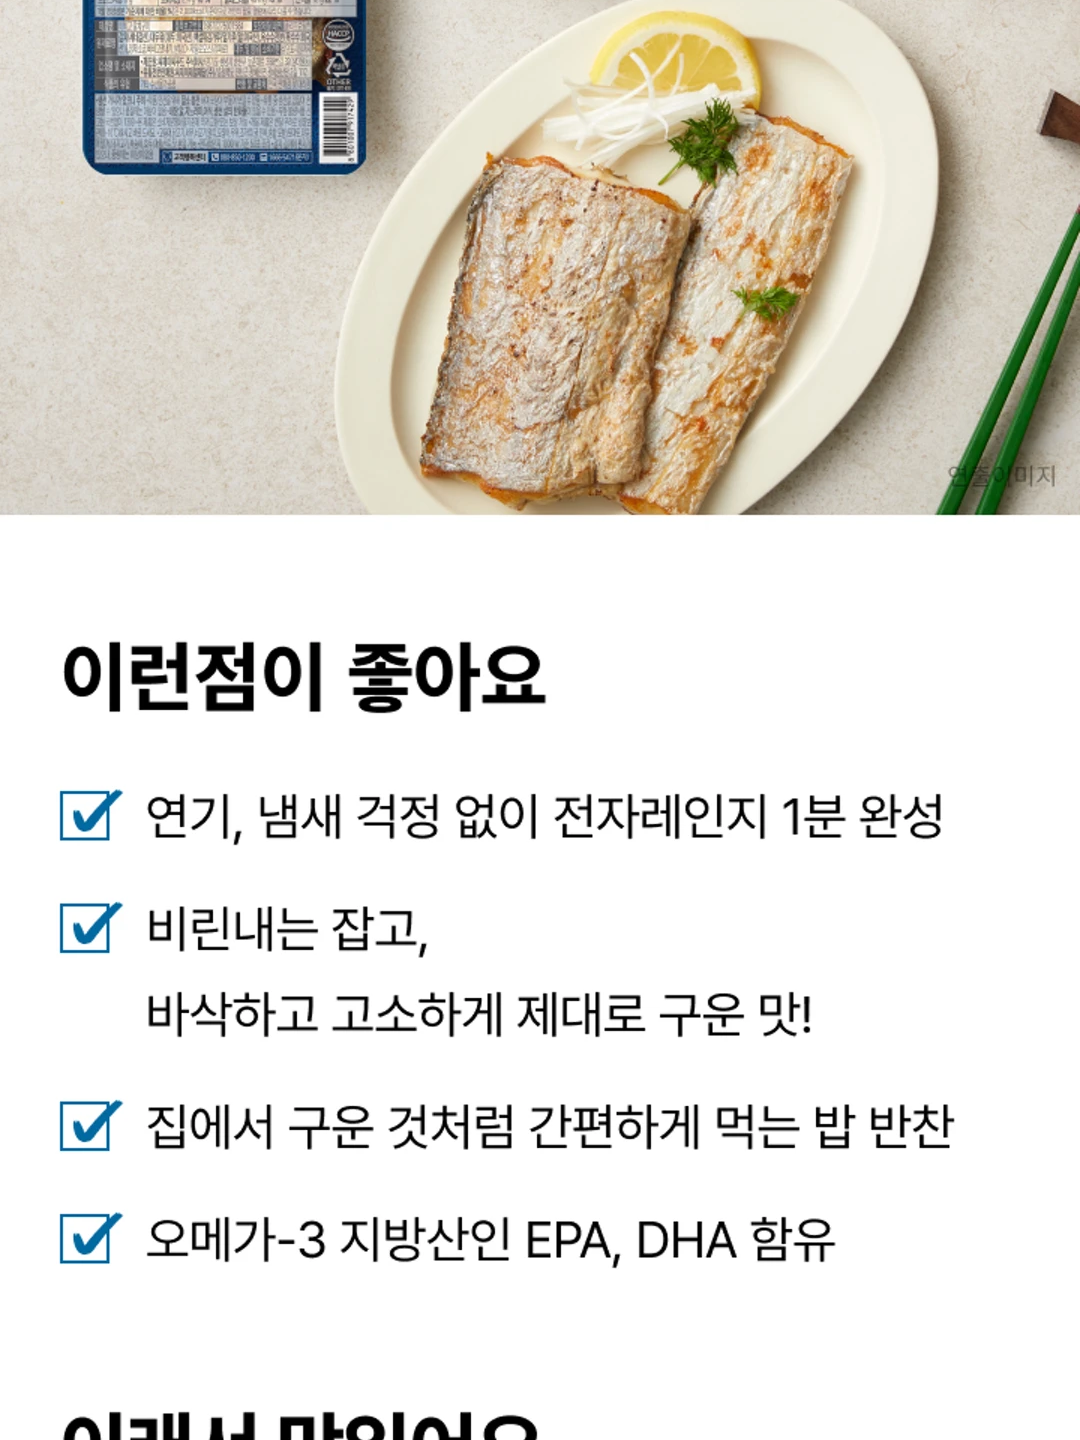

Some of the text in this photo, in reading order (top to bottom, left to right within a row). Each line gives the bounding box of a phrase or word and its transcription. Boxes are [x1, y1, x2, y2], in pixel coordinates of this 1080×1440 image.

[63, 641, 546, 714] 이런점이 좋아요
[147, 793, 941, 846] 연기, 냄새 걱정 없이 전자레인지 1분 완성
[149, 905, 427, 958] 비린내는 잡고,
[148, 991, 811, 1038] 바삭하고 고소하게 제대로 구운 맛!
[147, 1103, 955, 1150] 집에서 구운 것처럼 간편하게 먹는 밥 반찬
[146, 1216, 836, 1269] 오메가-3 지방산인 EPA, DHA 함유
